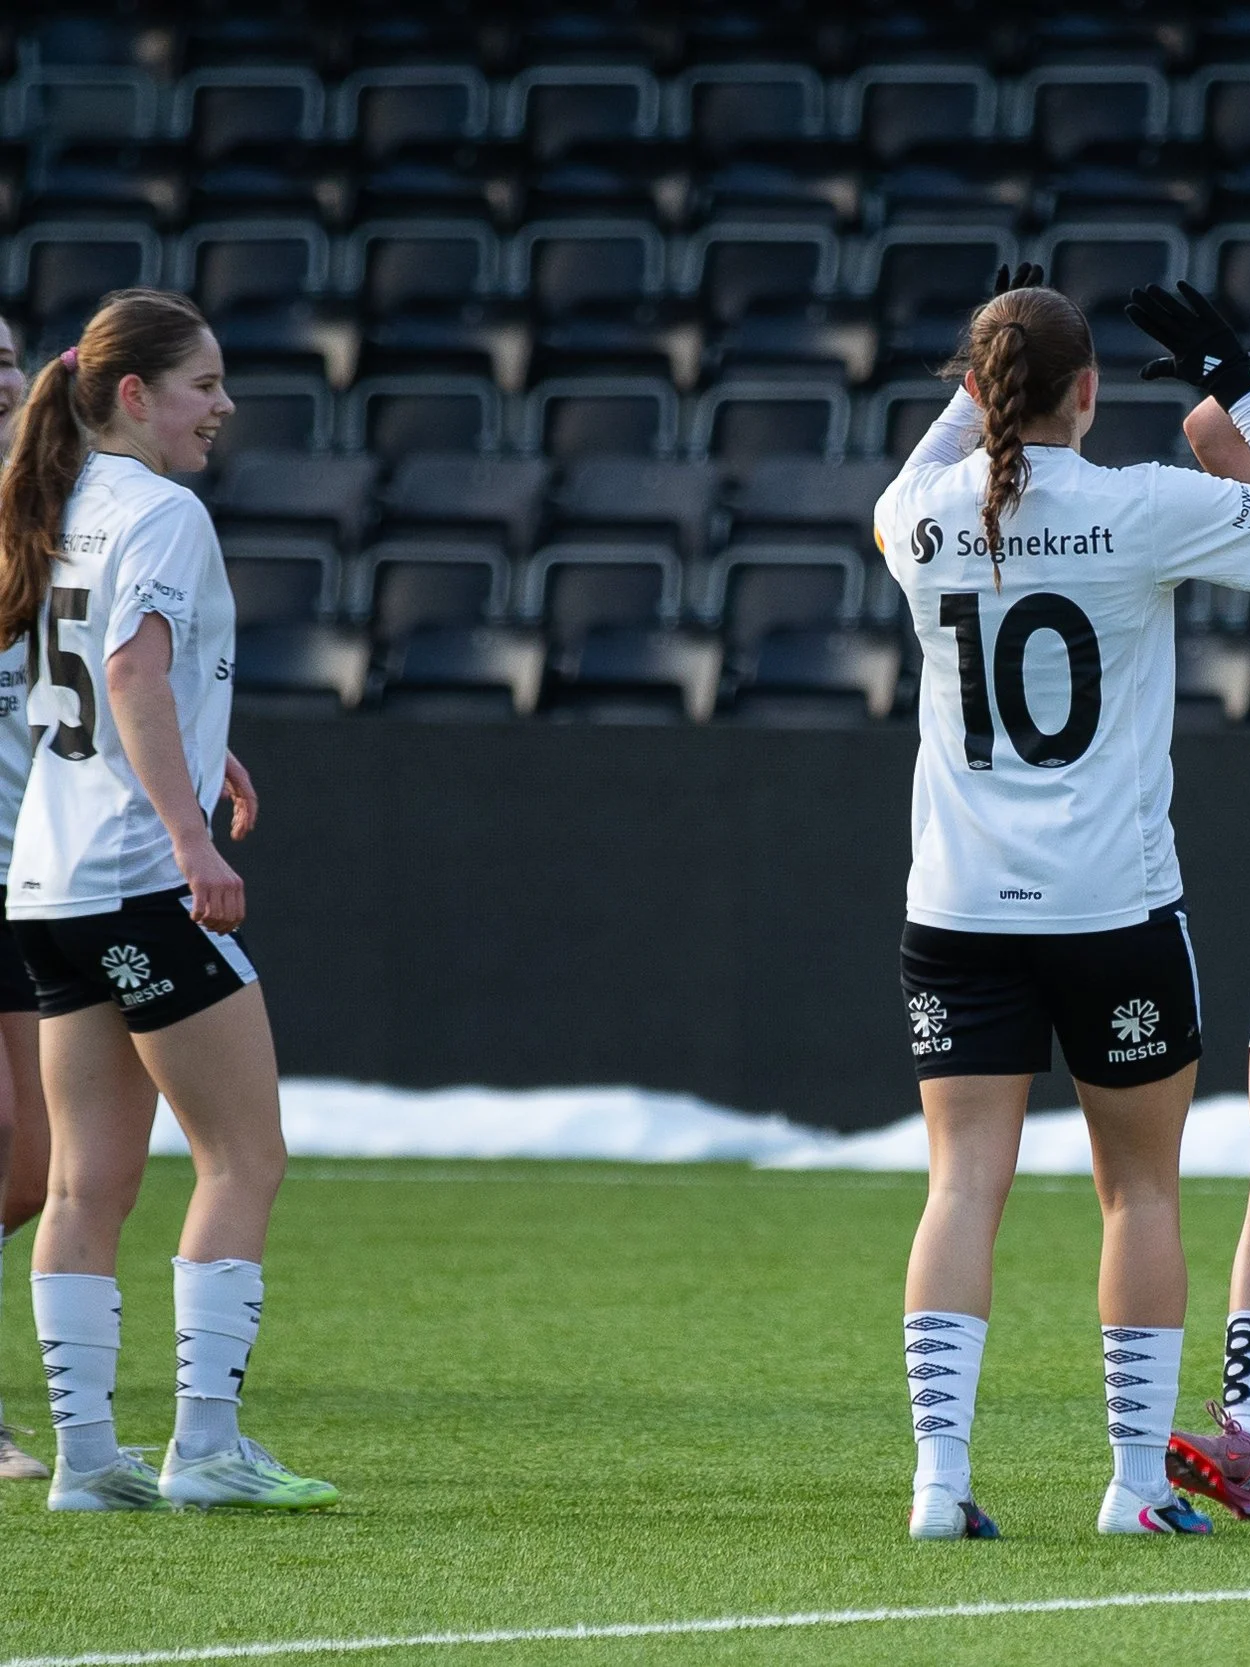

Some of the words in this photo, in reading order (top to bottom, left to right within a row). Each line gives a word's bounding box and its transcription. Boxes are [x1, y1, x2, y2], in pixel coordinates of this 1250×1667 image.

[957, 526, 1114, 564] Sognekraft
[939, 591, 1102, 771] 10
[1000, 888, 1043, 901] umbro
[122, 978, 175, 1007] mesta
[911, 1035, 953, 1056] mesta
[1108, 1039, 1167, 1063] mesta
